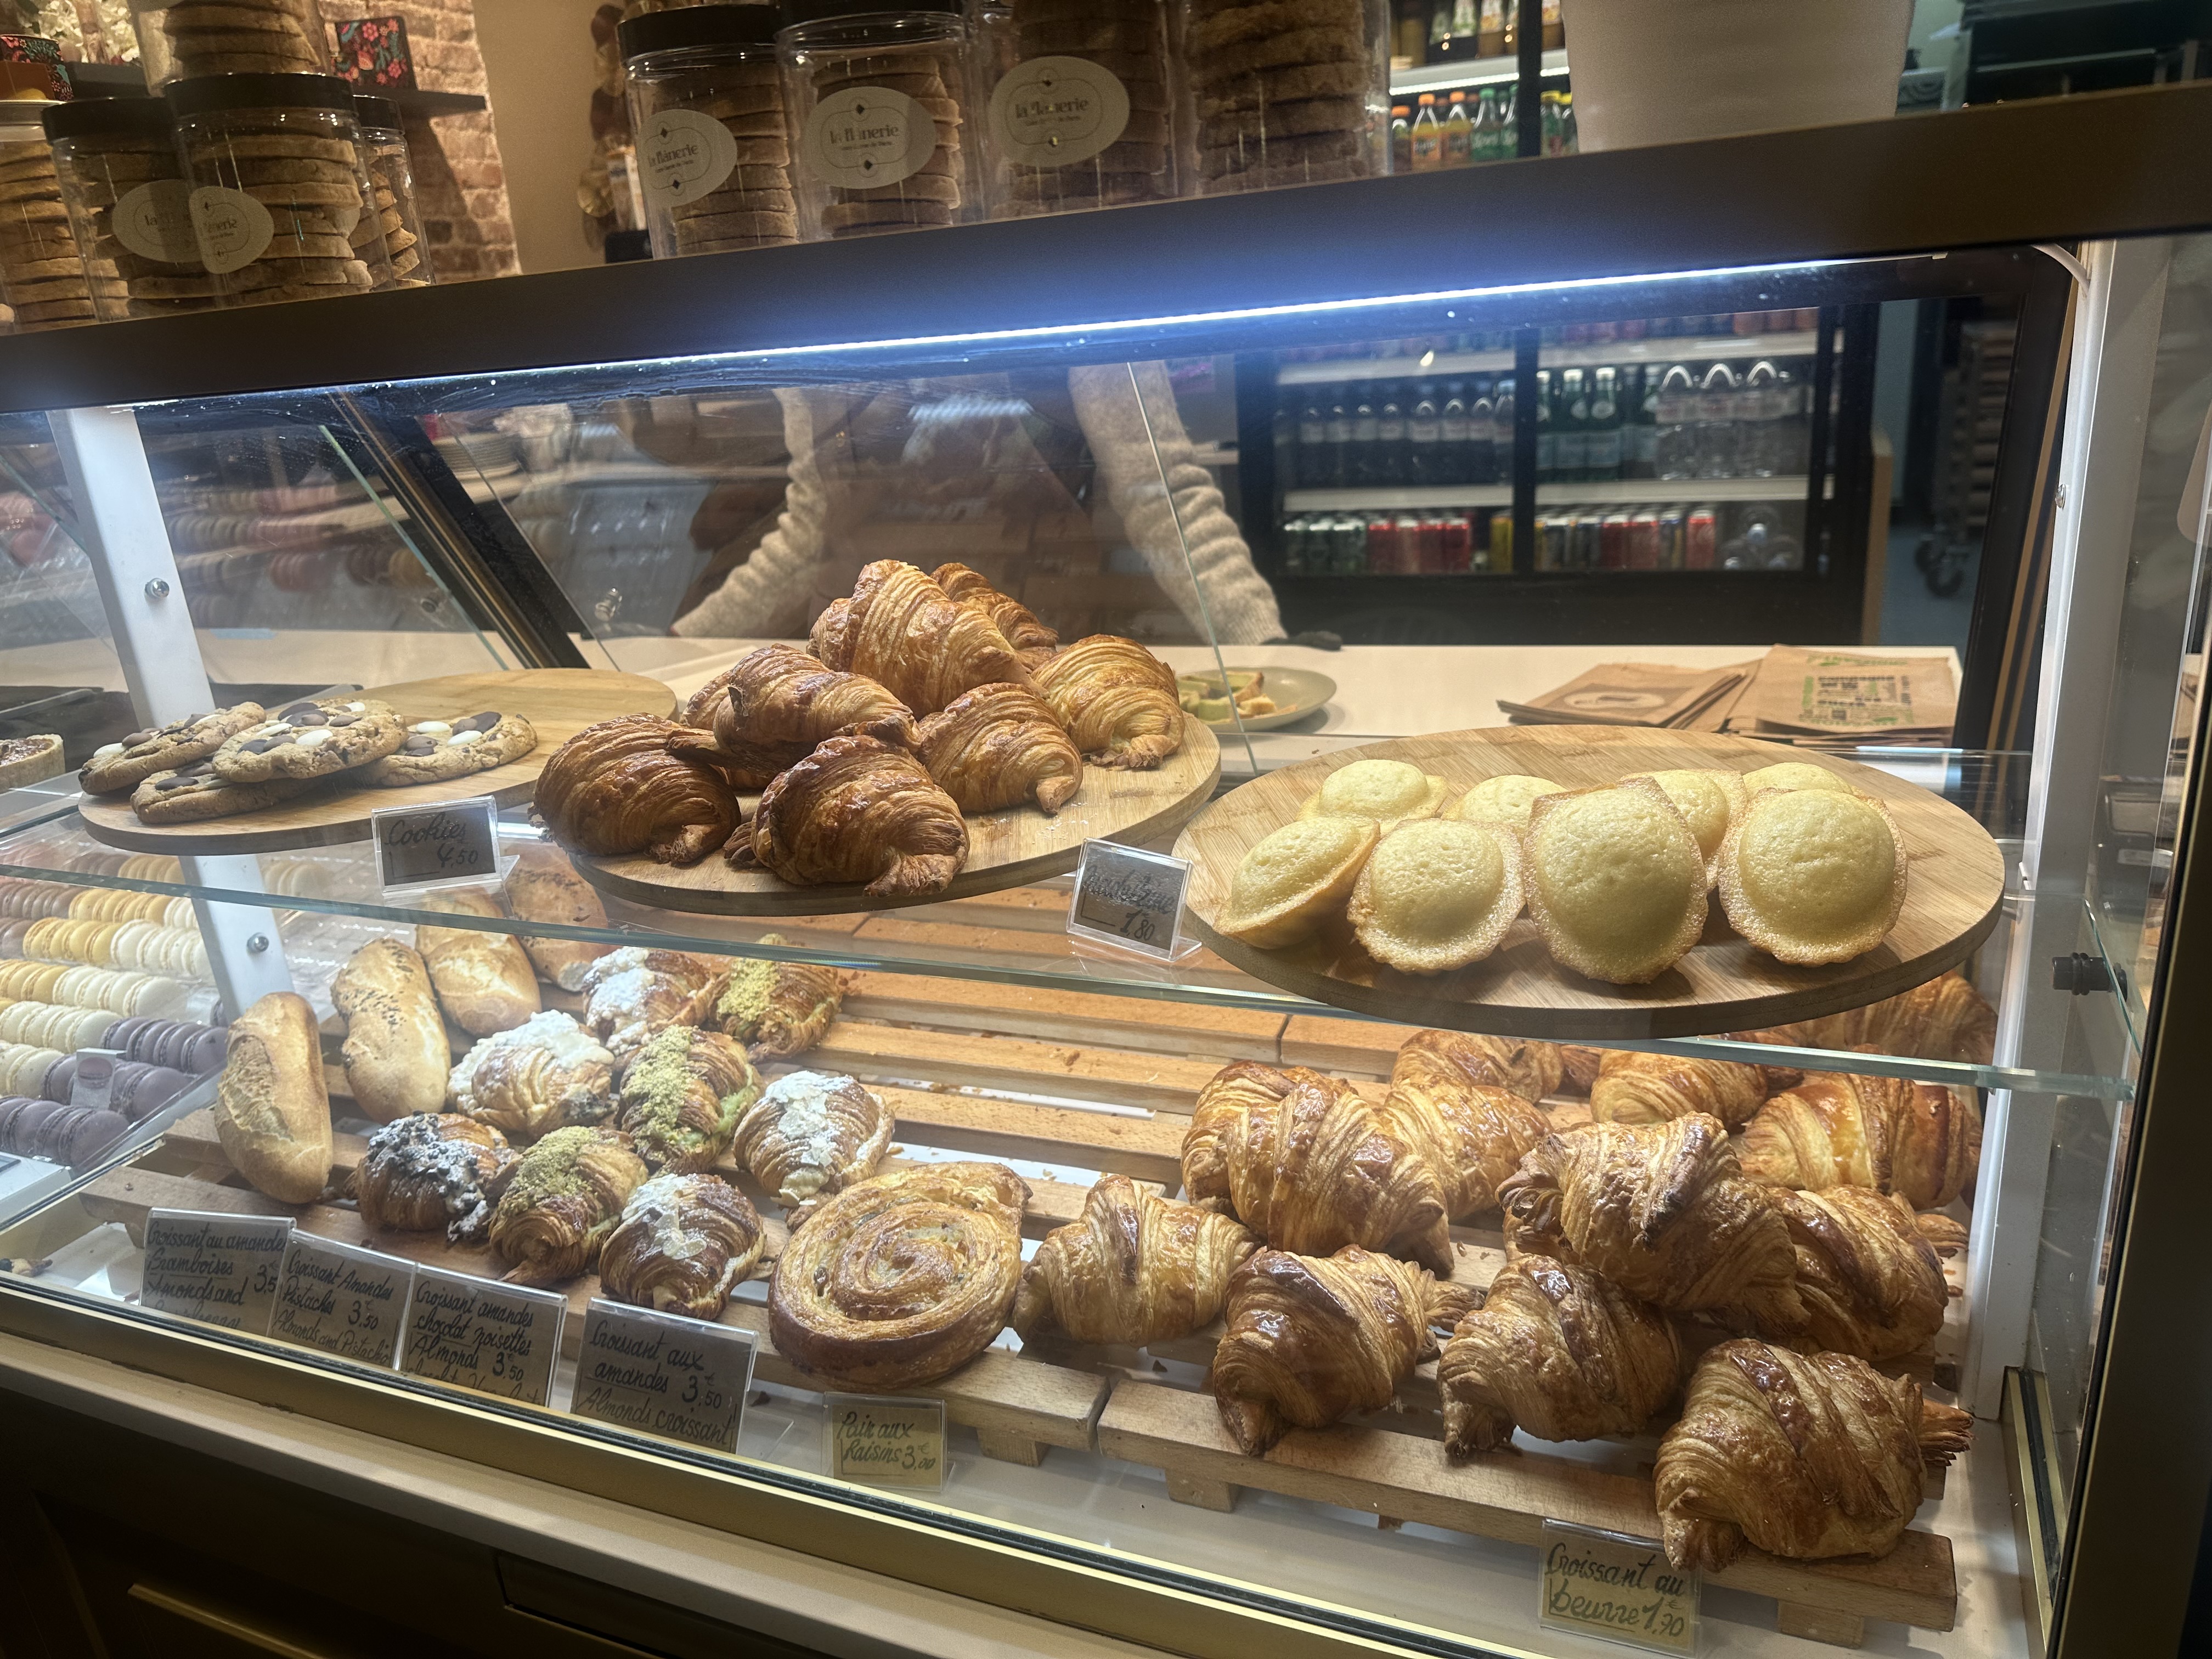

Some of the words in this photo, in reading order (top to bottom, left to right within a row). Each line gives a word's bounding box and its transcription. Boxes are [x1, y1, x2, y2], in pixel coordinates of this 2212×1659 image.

[385, 812, 466, 847] Cookies
[590, 1319, 666, 1360] Croissant
[667, 1348, 704, 1372] aux
[594, 1362, 669, 1393] amandes
[877, 1422, 915, 1440] aux
[1544, 1542, 1656, 1590] Croissant
[1654, 1575, 1685, 1597] au
[1551, 1578, 1640, 1624] beurre
